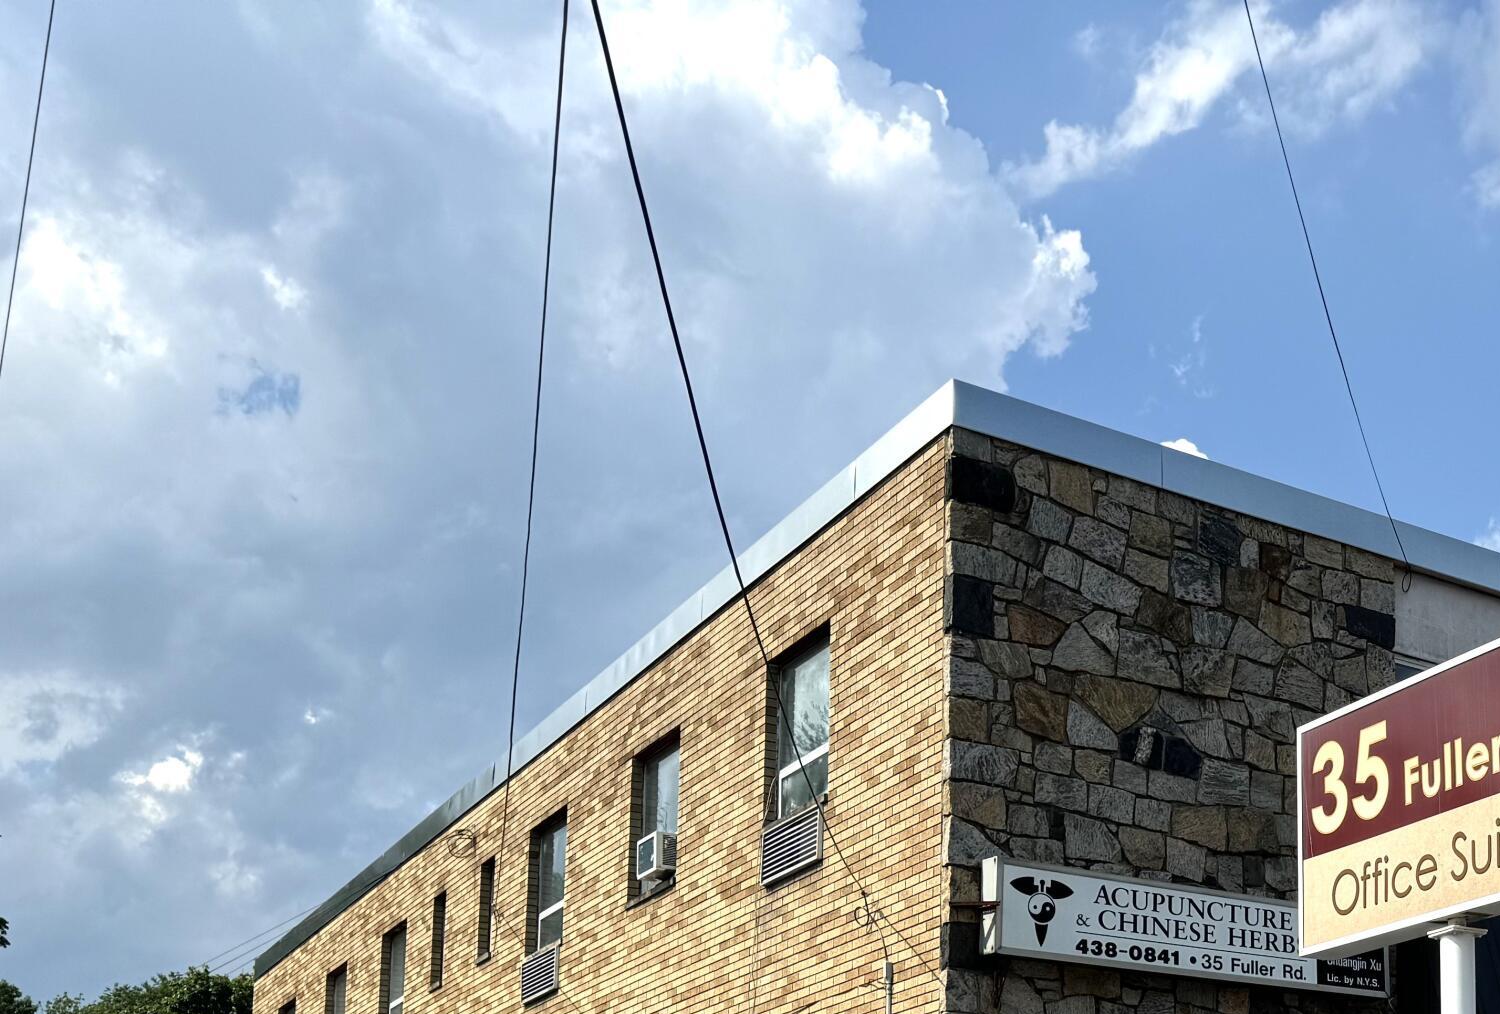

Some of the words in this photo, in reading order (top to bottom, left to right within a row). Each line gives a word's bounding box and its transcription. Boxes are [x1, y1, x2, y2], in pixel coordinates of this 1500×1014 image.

[1311, 719, 1390, 835] 35
[1093, 884, 1293, 931] ACUPUNCTURE
[1332, 854, 1438, 916] Office
[1076, 913, 1091, 927] &
[1098, 909, 1217, 944] CHINESE
[1227, 926, 1298, 954] HERB
[1075, 938, 1180, 966] 438-0841
[1201, 953, 1223, 971] 35
[1231, 957, 1275, 977] Fuller
[1283, 963, 1307, 981] Rd.
[1344, 975, 1354, 986] by
